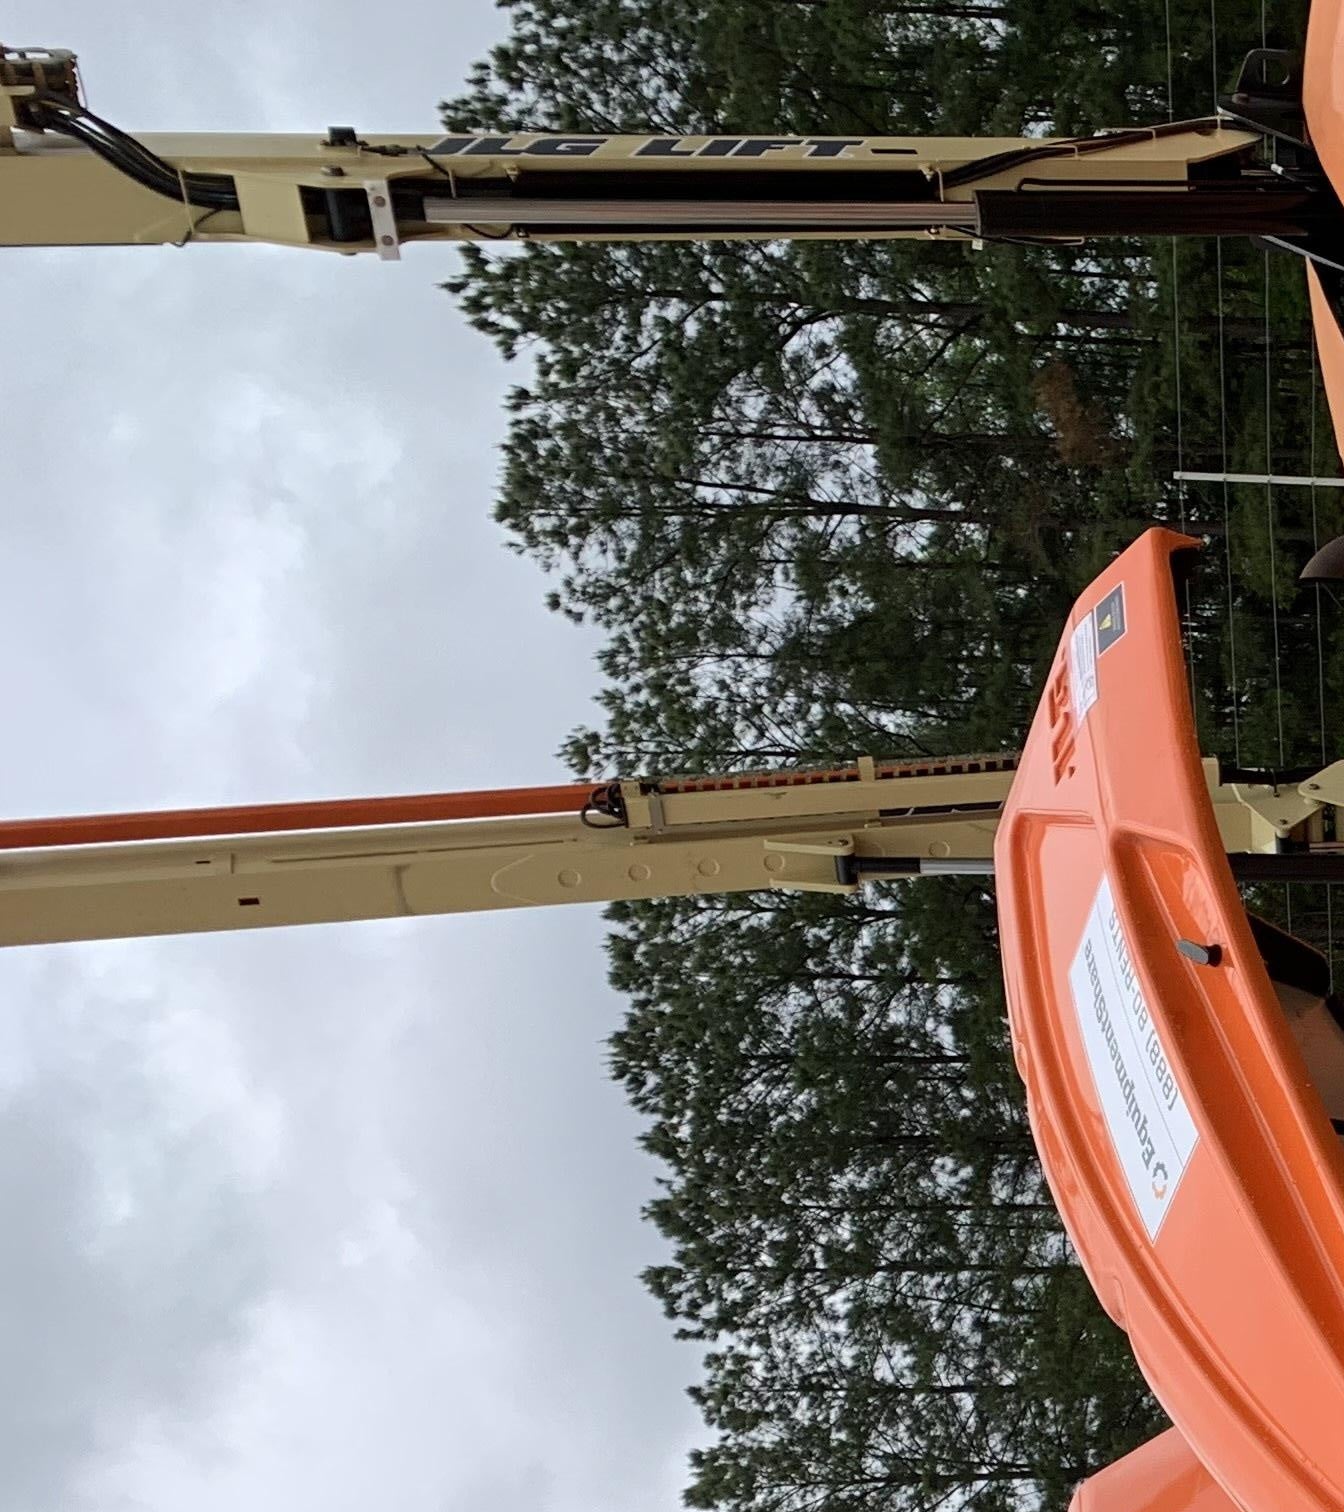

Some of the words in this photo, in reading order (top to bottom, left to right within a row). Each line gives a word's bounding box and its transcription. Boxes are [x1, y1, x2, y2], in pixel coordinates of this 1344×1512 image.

[634, 139, 865, 157] LIFT
[1107, 907, 1151, 1033] 80-RENTS
[1084, 938, 1157, 1169] EquipmentShare
[1143, 1028, 1179, 1111] (888)
